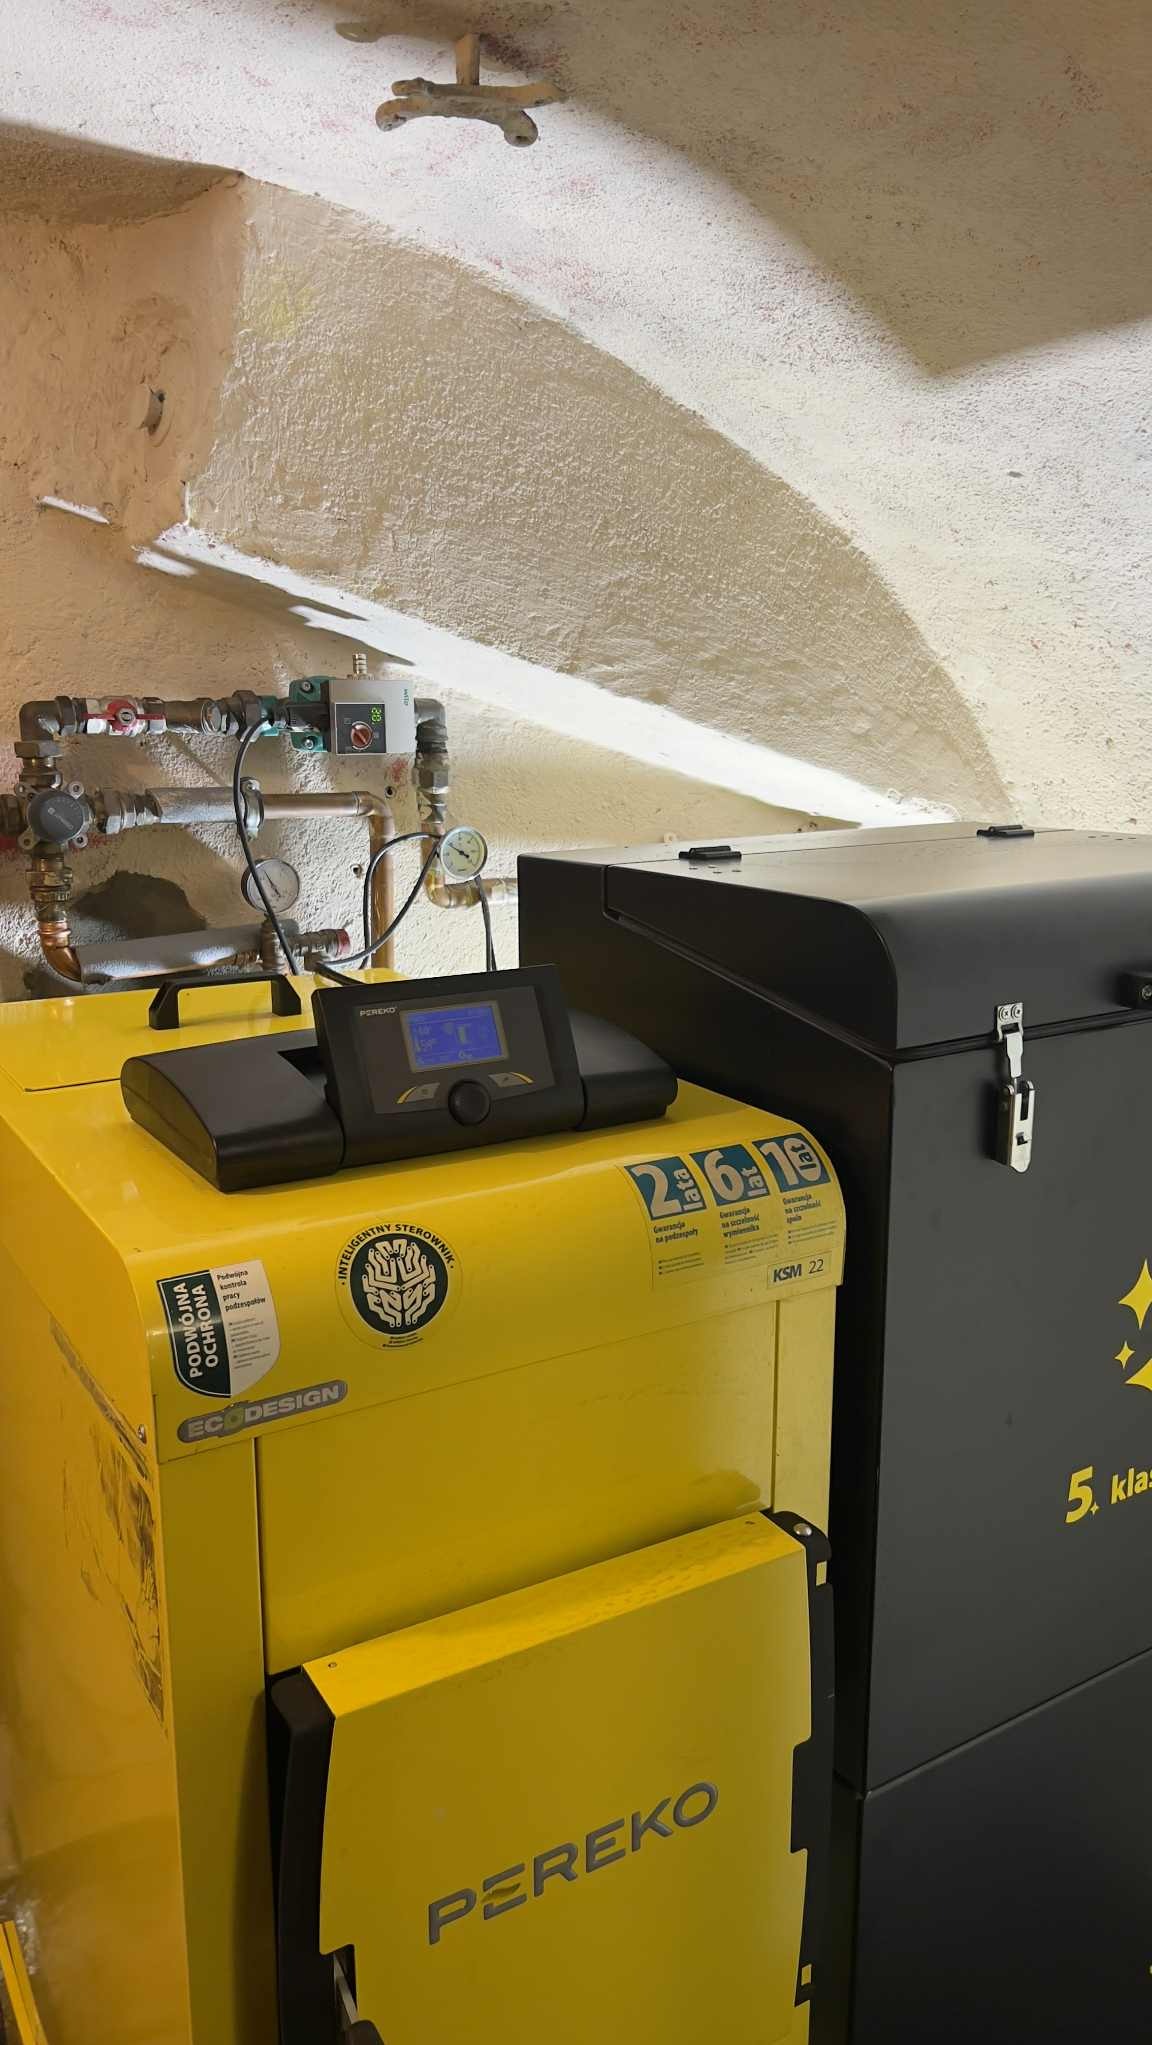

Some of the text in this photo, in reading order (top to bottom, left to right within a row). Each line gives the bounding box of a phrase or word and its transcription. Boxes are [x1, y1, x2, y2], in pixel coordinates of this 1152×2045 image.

[359, 1007, 396, 1017] PEREKO
[790, 1143, 818, 1171] lat
[704, 1150, 768, 1201] 6 lat
[630, 1164, 703, 1218] 2 lata
[653, 1221, 686, 1234] Gwarancja
[655, 1228, 698, 1244] na podzespoły
[338, 1223, 455, 1280] INTELIGENTNY STEROWNIK
[217, 1270, 249, 1281] Podwójna
[773, 1259, 824, 1283] KSM 22
[220, 1280, 247, 1291] kontrola
[223, 1292, 240, 1302] pracy
[225, 1297, 266, 1312] podzespołów
[173, 1281, 204, 1379] PODWÓJNA
[191, 1283, 219, 1368] OCHRONA
[187, 1384, 340, 1439] ECODESIGN
[1111, 1467, 1152, 1505] kla
[428, 1781, 719, 1946] PEREKO
